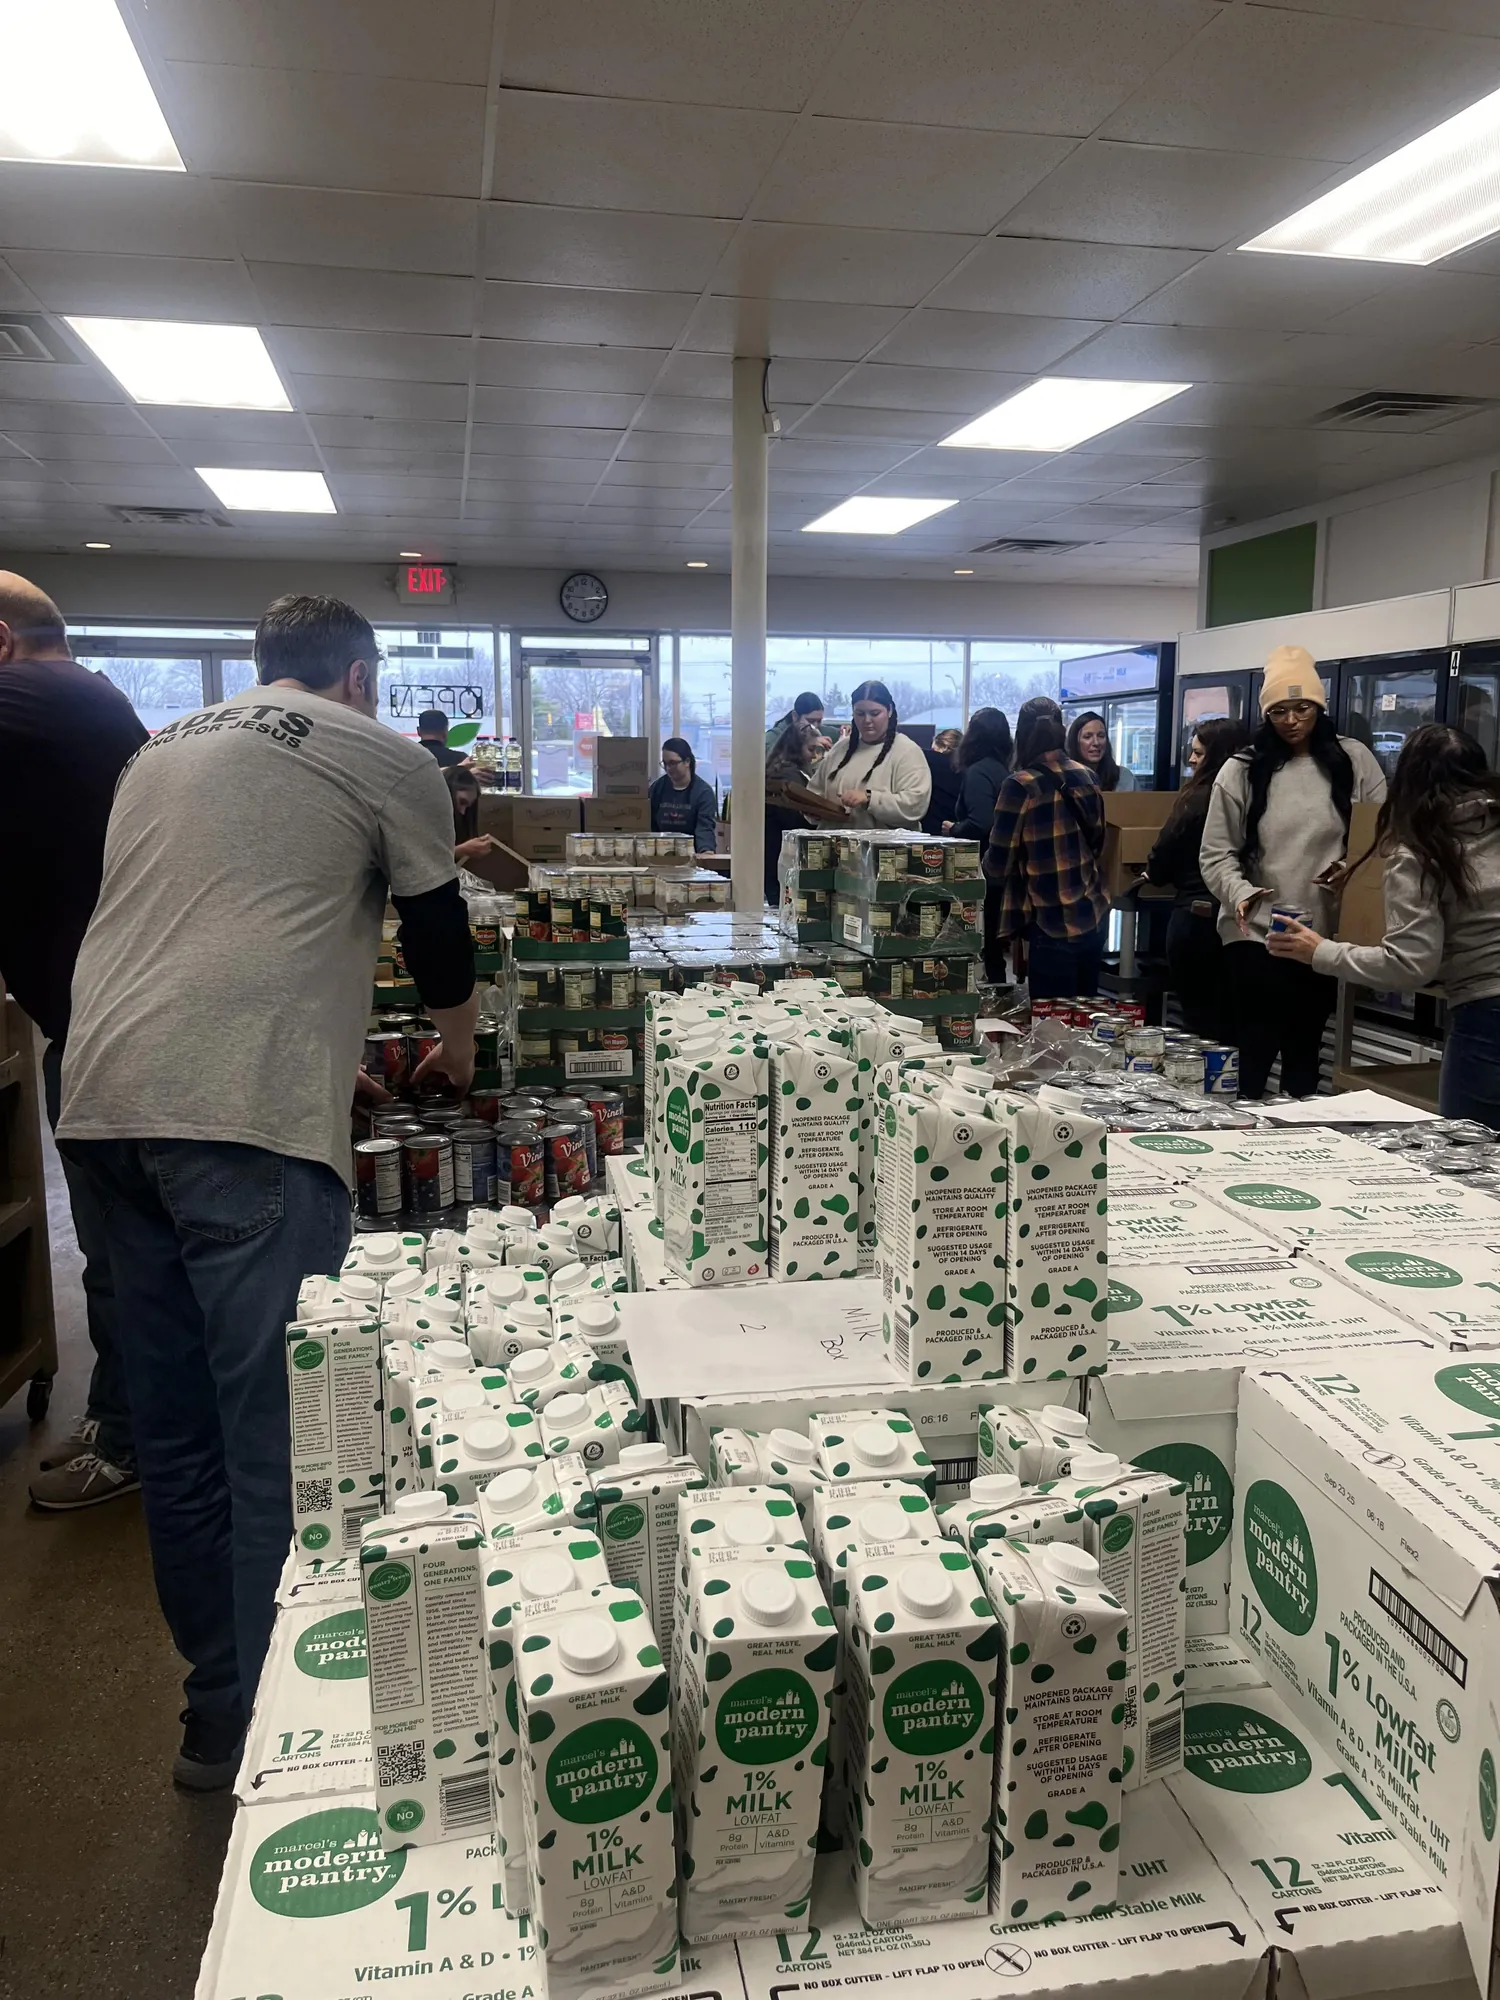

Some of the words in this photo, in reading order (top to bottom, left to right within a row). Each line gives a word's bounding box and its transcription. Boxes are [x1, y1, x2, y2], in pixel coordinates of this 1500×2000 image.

[408, 567, 443, 593] EXIT
[1452, 652, 1458, 673] 4
[181, 723, 224, 740] FOR
[228, 720, 301, 749] JESUS
[705, 1103, 734, 1111] Nutrition
[739, 1122, 756, 1130] 110
[925, 1188, 962, 1196] UNOPENED
[964, 1186, 996, 1194] PACKAGE
[926, 1194, 962, 1202] MAINTAINS
[964, 1193, 994, 1201] QUALITY
[935, 1212, 984, 1220] TEMPERATURE
[932, 1231, 954, 1239] AFTER
[956, 1230, 987, 1238] OPENING
[936, 1224, 983, 1232] REFRIGERATE
[589, 1254, 608, 1262] Facts
[1361, 1264, 1440, 1273] modern
[1381, 1270, 1451, 1280] pantry
[1151, 1303, 1213, 1327] 1%
[1213, 1297, 1316, 1315] Lowfat
[1250, 1309, 1316, 1323] Milk
[841, 1308, 883, 1341] Milk
[821, 1335, 849, 1360] Box
[921, 1414, 948, 1424] 06:16
[1400, 1415, 1444, 1446] Vitamin
[1412, 1457, 1442, 1480] Grade
[1324, 1473, 1343, 1489] Sep
[1366, 1508, 1385, 1531] 06:16
[1254, 1504, 1284, 1539] marcel's
[1249, 1517, 1308, 1589] modern
[423, 1561, 445, 1569] FOUR
[423, 1565, 478, 1578] GENERATIONS,
[424, 1578, 442, 1586] ONE
[444, 1574, 472, 1585] FAMILY
[1256, 1547, 1310, 1615] pantry
[1241, 1594, 1262, 1646] 12
[313, 1628, 364, 1640] marcel's
[1353, 1610, 1390, 1652] PRODUCED
[1390, 1649, 1405, 1671] AND
[1340, 1611, 1375, 1659] PACKAGED
[1376, 1652, 1382, 1666] IN
[1383, 1656, 1397, 1679] THE
[1398, 1672, 1417, 1701] U.S.A.
[731, 1695, 772, 1707] marcel's
[896, 1687, 937, 1699] marcel's
[1023, 1689, 1070, 1702] UNOPENED
[1072, 1686, 1113, 1696] PACKAGE
[1025, 1696, 1071, 1710] MAINTAINS
[1073, 1693, 1112, 1703] QUALITY
[891, 1697, 970, 1716] modern
[1325, 1631, 1360, 1699] 1%
[1366, 1674, 1436, 1774] Lowfat
[724, 1707, 805, 1724] modern
[903, 1711, 974, 1734] pantry
[1033, 1713, 1062, 1724] STORE
[1064, 1712, 1074, 1720] AT
[1076, 1709, 1102, 1717] ROOM
[1037, 1716, 1098, 1730] TEMPERATURE
[389, 1721, 408, 1729] MORE
[734, 1722, 808, 1743] pantry
[278, 1728, 324, 1755] 12
[1033, 1744, 1062, 1755] AFTER
[1062, 1739, 1101, 1750] OPENING
[1038, 1732, 1096, 1746] REFRIGERATE
[1183, 1734, 1285, 1756] modern
[272, 1751, 321, 1763] CARTONS
[560, 1749, 605, 1767] marcel's
[1026, 1757, 1076, 1771] SUGGESTED
[1078, 1754, 1108, 1763] USAGE
[1206, 1748, 1297, 1773] pantry
[1307, 1678, 1339, 1723] Vitamin
[1340, 1718, 1347, 1734] A
[1348, 1727, 1355, 1744] &
[1357, 1737, 1364, 1753] D
[1374, 1754, 1386, 1780] 1%
[1388, 1772, 1420, 1820] Milkfat
[1430, 1818, 1450, 1852] UHT
[1375, 1720, 1420, 1794] Milk
[556, 1755, 643, 1786] modern
[915, 1760, 947, 1782] 1%
[1034, 1767, 1065, 1777] WITHIN
[1079, 1763, 1100, 1771] DAYS
[1040, 1775, 1052, 1783] OF
[1055, 1770, 1093, 1781] OPENING
[570, 1771, 648, 1804] pantry
[744, 1770, 776, 1791] 1%
[900, 1780, 964, 1805] MILK
[1048, 1788, 1077, 1798] GRADE
[726, 1791, 793, 1814] MILK
[1336, 1738, 1360, 1773] Grade
[1361, 1767, 1368, 1783] A
[1376, 1784, 1398, 1818] Shelf
[1400, 1811, 1427, 1853] Stable
[1429, 1845, 1448, 1878] Milk
[397, 1812, 414, 1821] NO
[734, 1813, 781, 1826] LOWFAT
[587, 1826, 623, 1852] 1%
[720, 1842, 748, 1851] Protein
[759, 1838, 795, 1848] Vitamins
[729, 1833, 742, 1843] 8g
[766, 1829, 789, 1838] A&D
[274, 1839, 337, 1855] marcel's
[263, 1848, 386, 1873] modern
[573, 1844, 644, 1880] MILK
[1036, 1858, 1083, 1870] PRODUCED
[1131, 1860, 1168, 1877] UHT
[1022, 1866, 1068, 1879] PACKAGED
[1082, 1861, 1105, 1871] U.S.A.
[1250, 1856, 1314, 1889] 12
[279, 1865, 391, 1894] pantry
[584, 1869, 633, 1891] LOWFAT
[1272, 1886, 1322, 1899] CARTONS
[1116, 1901, 1168, 1917] Stable
[1172, 1892, 1206, 1906] Milk
[394, 1886, 477, 1952] 1%
[776, 1926, 828, 1962] 12
[355, 1960, 433, 1982] Vitamin
[439, 1957, 453, 1972] A
[460, 1955, 474, 1969] &
[481, 1952, 494, 1967] D
[776, 1960, 832, 1974] CARTONS
[804, 1981, 819, 1990] NO
[822, 1978, 842, 1988] BOX
[844, 1974, 882, 1985] CUTTER
[892, 1969, 912, 1979] LIFT
[916, 1966, 940, 1976] FLAP
[958, 1958, 985, 1970] OPEN
